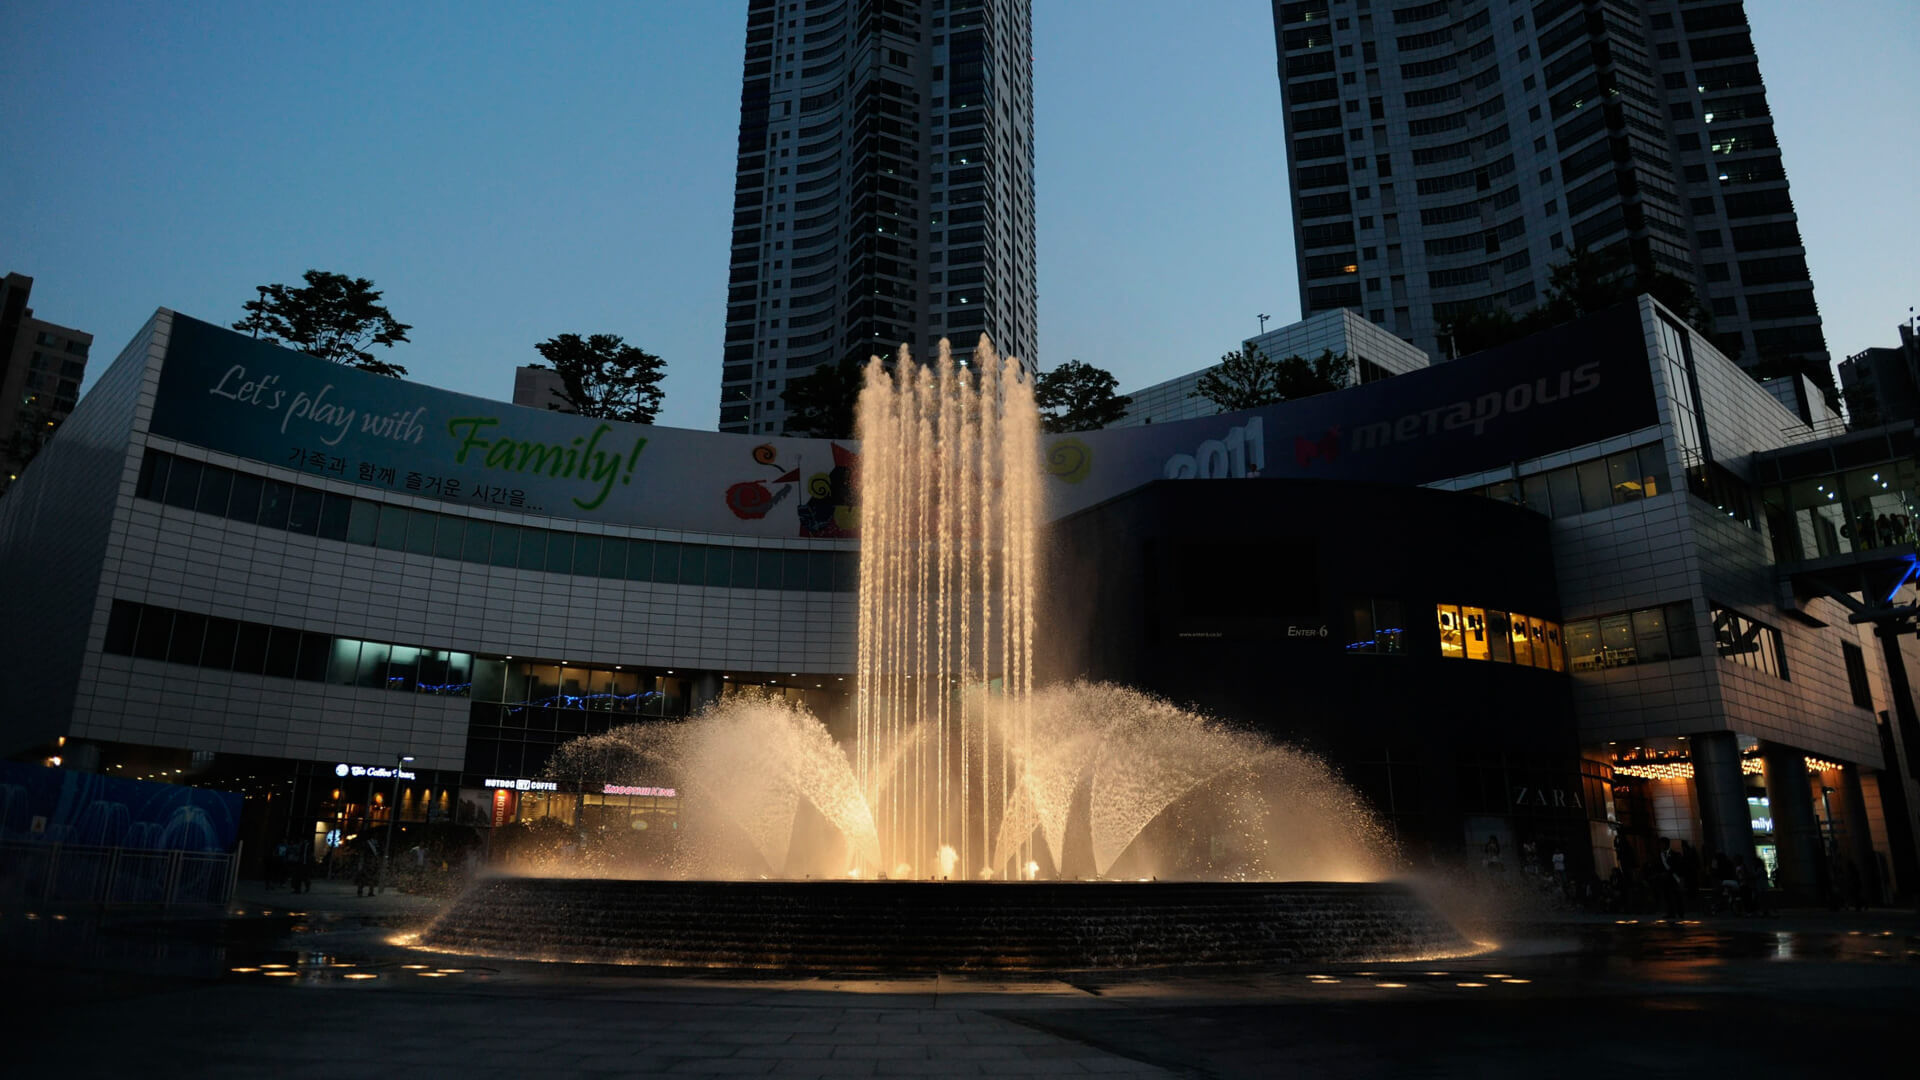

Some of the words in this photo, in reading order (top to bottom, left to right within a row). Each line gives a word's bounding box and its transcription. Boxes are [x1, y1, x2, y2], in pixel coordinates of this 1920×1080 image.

[209, 364, 287, 410] Let's
[280, 384, 356, 446] play
[360, 406, 428, 444] with
[448, 417, 649, 510] Family!
[289, 447, 346, 475] 가족과
[359, 461, 396, 485] 함께
[406, 471, 461, 497] 즐거운
[472, 484, 544, 511] 시간을...
[530, 782, 557, 790] COFFEE
[1515, 787, 1583, 808] ZARA
